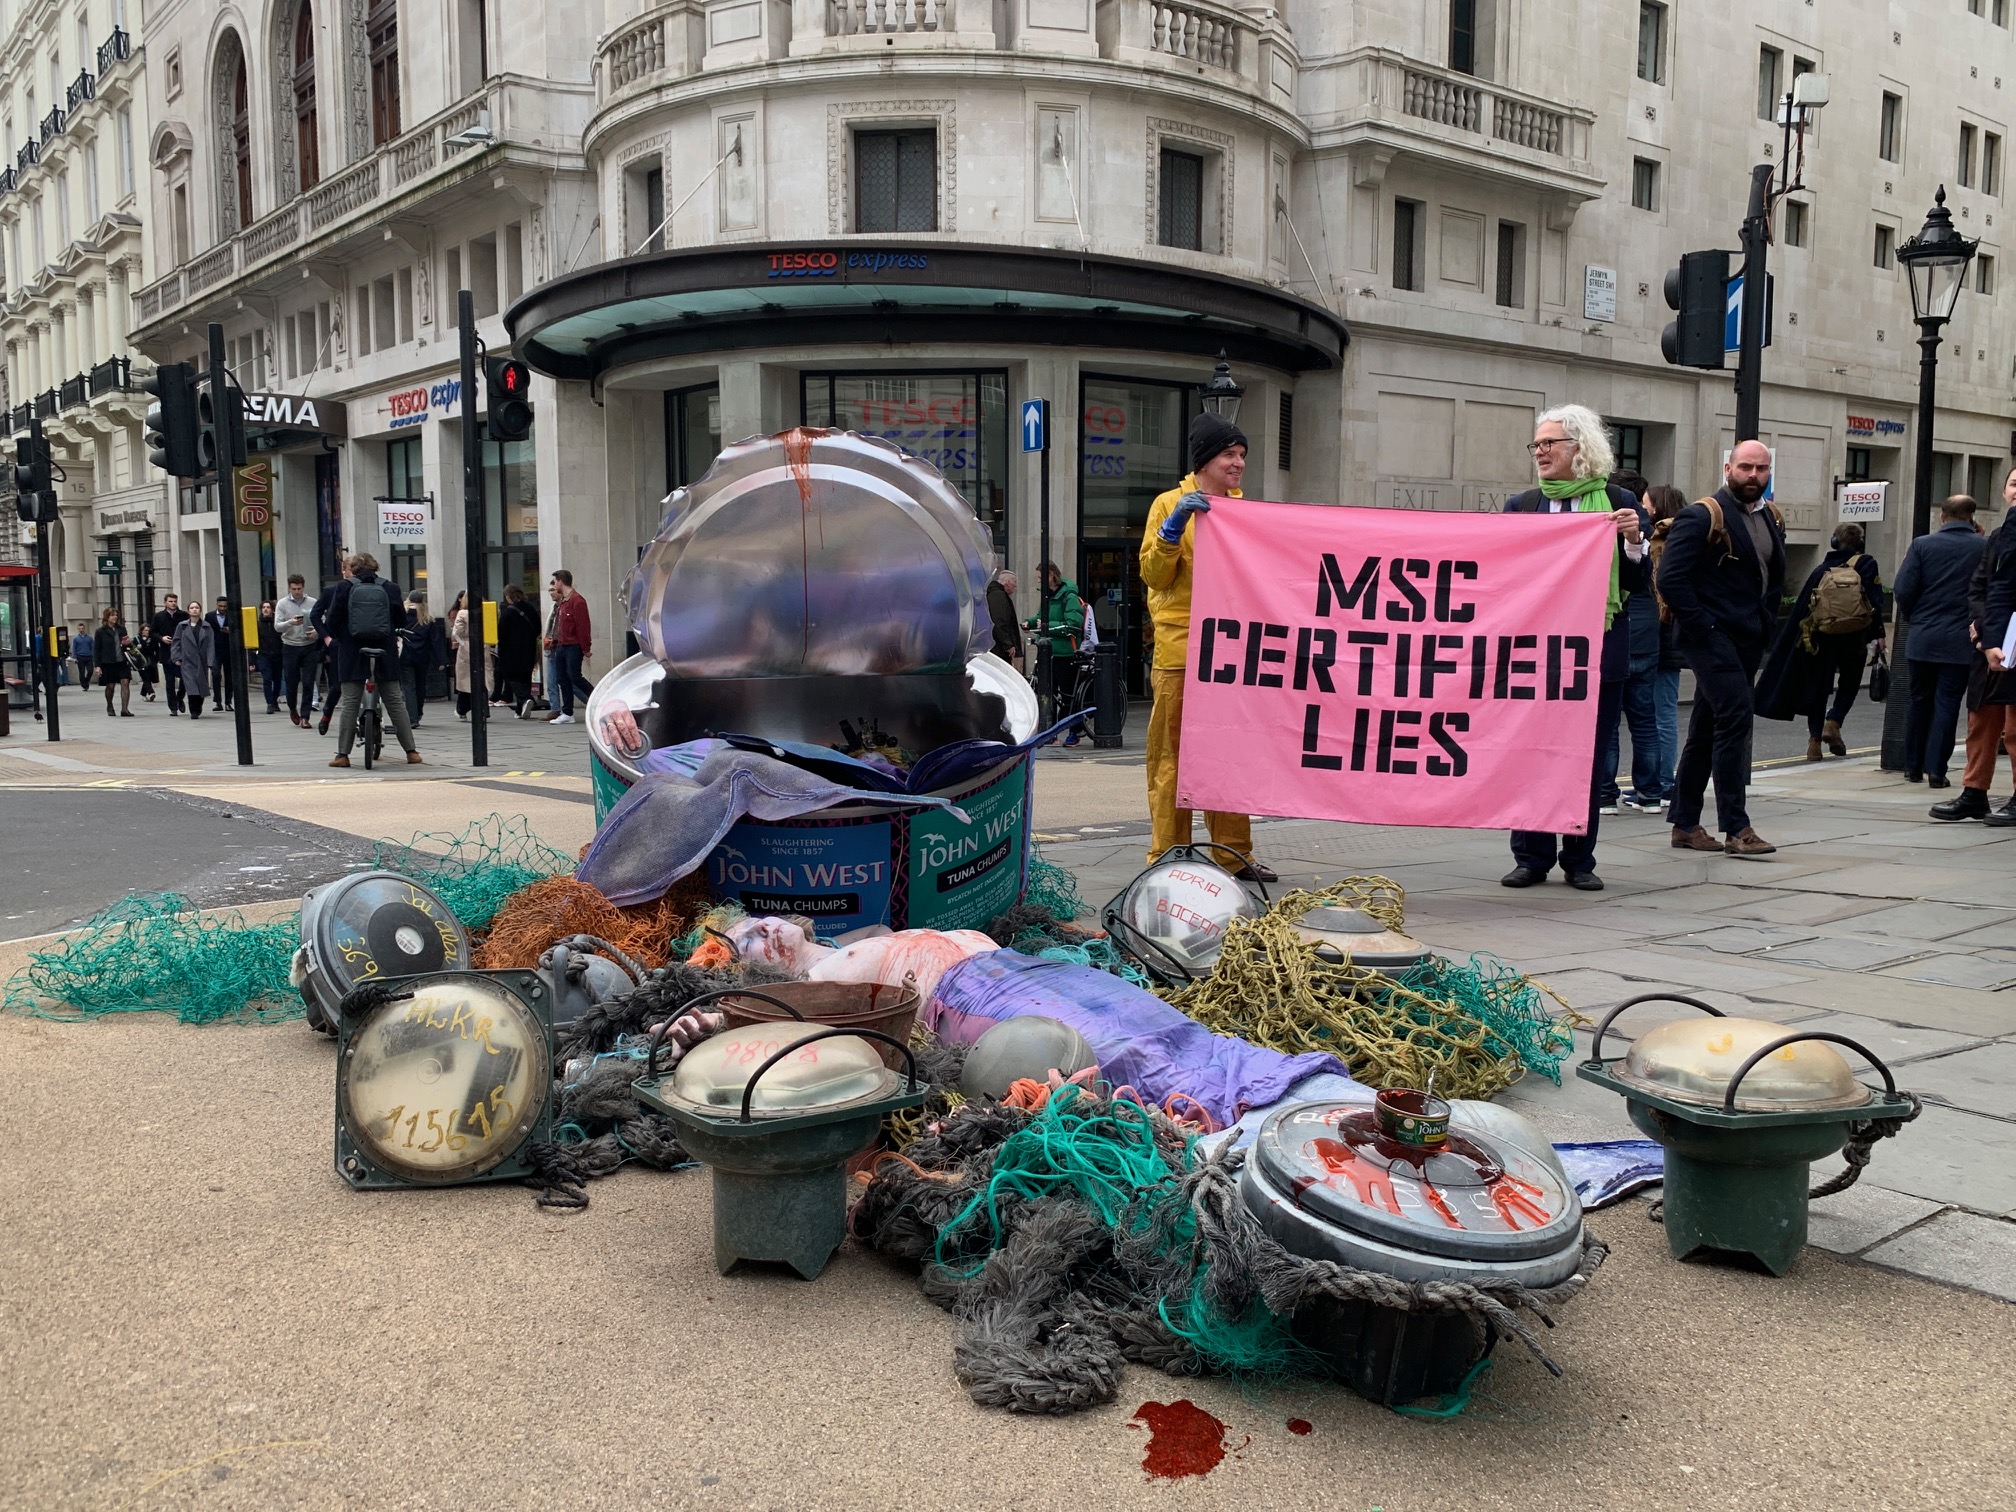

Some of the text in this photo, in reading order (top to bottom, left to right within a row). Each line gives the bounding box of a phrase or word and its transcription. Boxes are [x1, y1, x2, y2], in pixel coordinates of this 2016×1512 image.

[767, 252, 928, 272] TESCO express
[1589, 279, 1605, 288] STREET
[1590, 270, 1608, 280] JERMYN
[388, 388, 428, 417] TESCO
[243, 395, 320, 428] EMA
[853, 396, 985, 427] TESCO
[1846, 415, 1905, 436] TESCO express
[72, 483, 86, 493] 15
[1392, 488, 1438, 510] EXIT
[1843, 492, 1880, 502] TESCO
[383, 512, 424, 521] TESCO
[1785, 508, 1815, 523] EXIT
[1842, 505, 1880, 515] express
[383, 526, 425, 537] express
[1315, 553, 1479, 623] MSC
[1198, 617, 1590, 701] CERTIFIED
[1301, 704, 1470, 777] LIES
[966, 791, 1004, 815] AUGHTERING
[986, 802, 998, 815] 1857
[761, 838, 834, 847] SLAUGHTERING
[918, 798, 1023, 877] JOHN WEST
[772, 847, 823, 855] SINCE 1857
[717, 856, 885, 888] JOHN WEST
[947, 844, 1007, 884] TUNA CHUMPS
[972, 882, 983, 893] NOT
[1168, 869, 1222, 897] ADRIA
[752, 898, 848, 911] TUNA CHUMPS
[1419, 1125, 1440, 1135] JOHN
